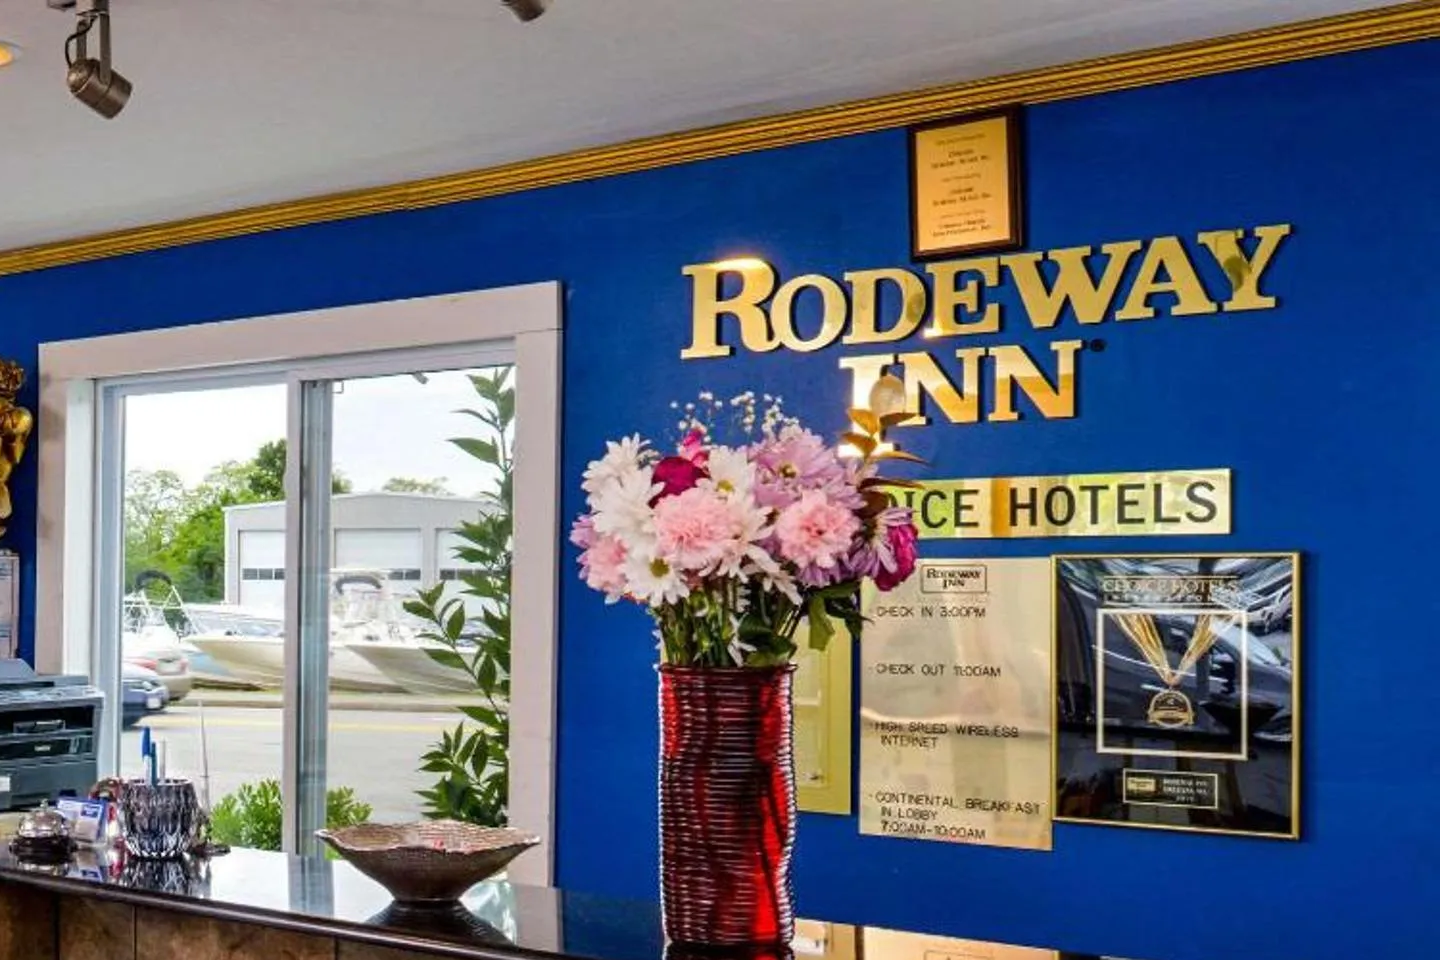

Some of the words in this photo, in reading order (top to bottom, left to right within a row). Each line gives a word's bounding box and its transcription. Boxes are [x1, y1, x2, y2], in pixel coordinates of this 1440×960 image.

[680, 224, 1291, 360] RODEWAY
[838, 339, 1083, 457] INN
[1008, 481, 1218, 527] HOTELS
[876, 607, 914, 618] CHECK
[921, 607, 933, 618] IN
[939, 606, 986, 618] 3:00PM
[876, 663, 915, 675] CHECK
[921, 664, 945, 676] OUT
[875, 721, 902, 733] HIGH
[909, 723, 948, 735] SPEED
[955, 724, 1020, 738] WIRELESS
[880, 735, 939, 748] INTERNET
[875, 792, 958, 809] CONTINENTAL
[965, 798, 1041, 815] BREAKFAST
[880, 807, 892, 817] IN
[897, 809, 938, 821] LOBBY
